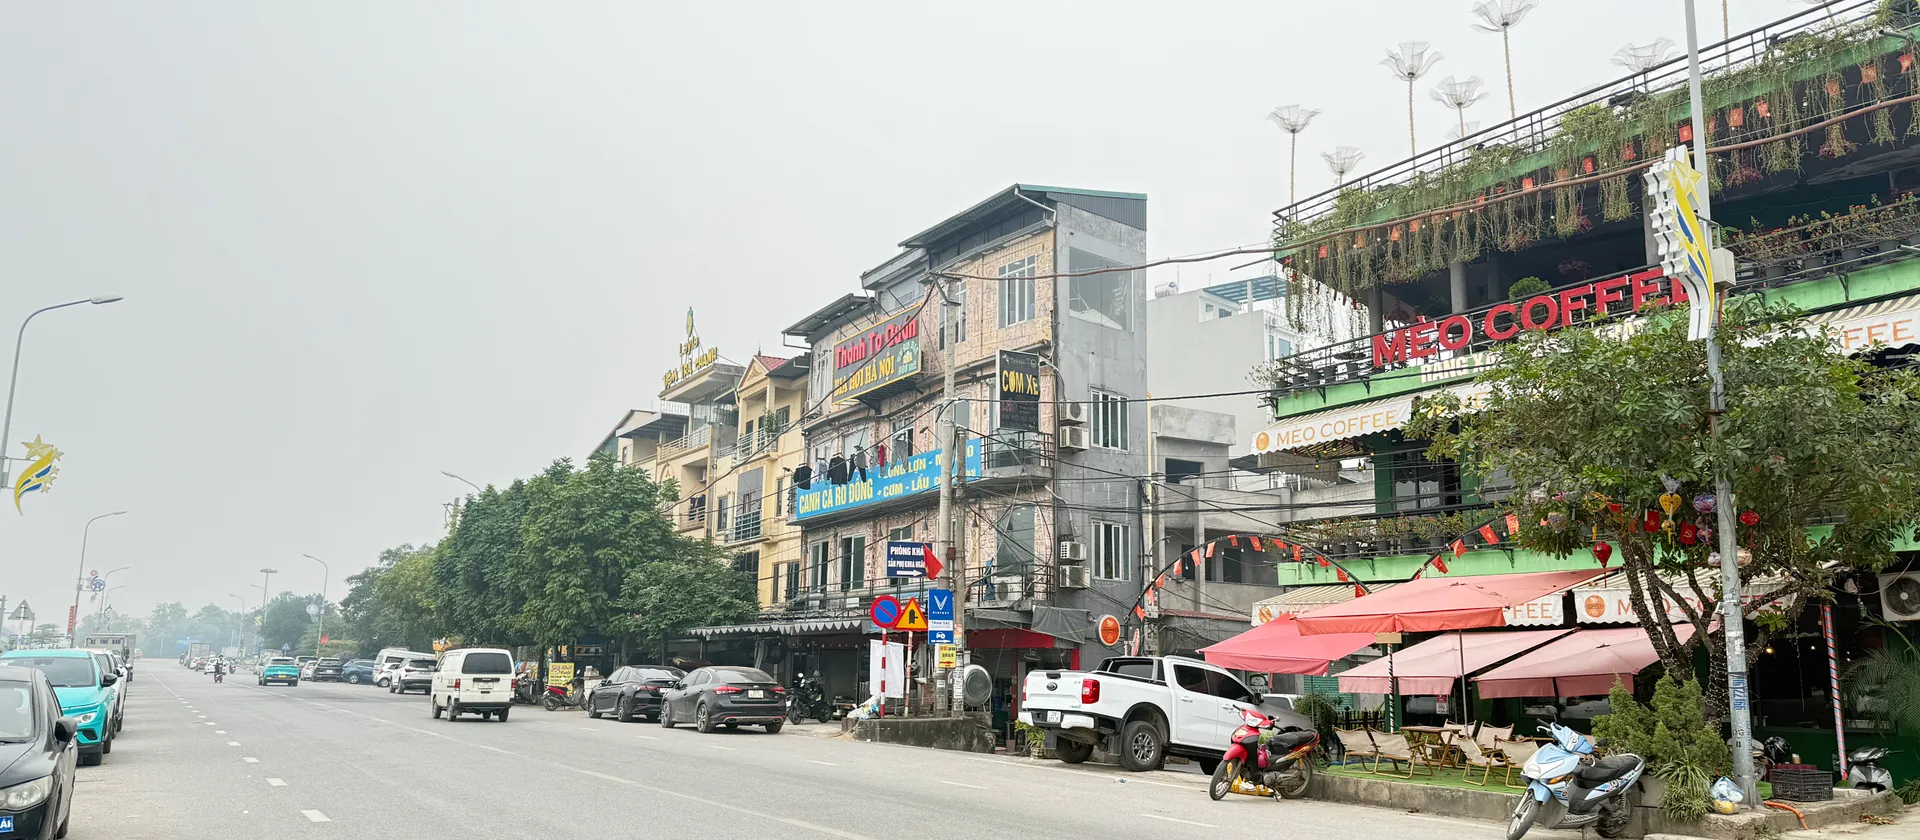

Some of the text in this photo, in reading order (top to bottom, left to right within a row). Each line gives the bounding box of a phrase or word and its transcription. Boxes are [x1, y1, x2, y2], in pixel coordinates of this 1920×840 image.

[1373, 315, 1472, 367] MÈO
[1320, 410, 1398, 438] COFFEE
[799, 490, 820, 514] CANH
[822, 477, 834, 509] CÁ
[890, 545, 911, 556] PHÒNG
